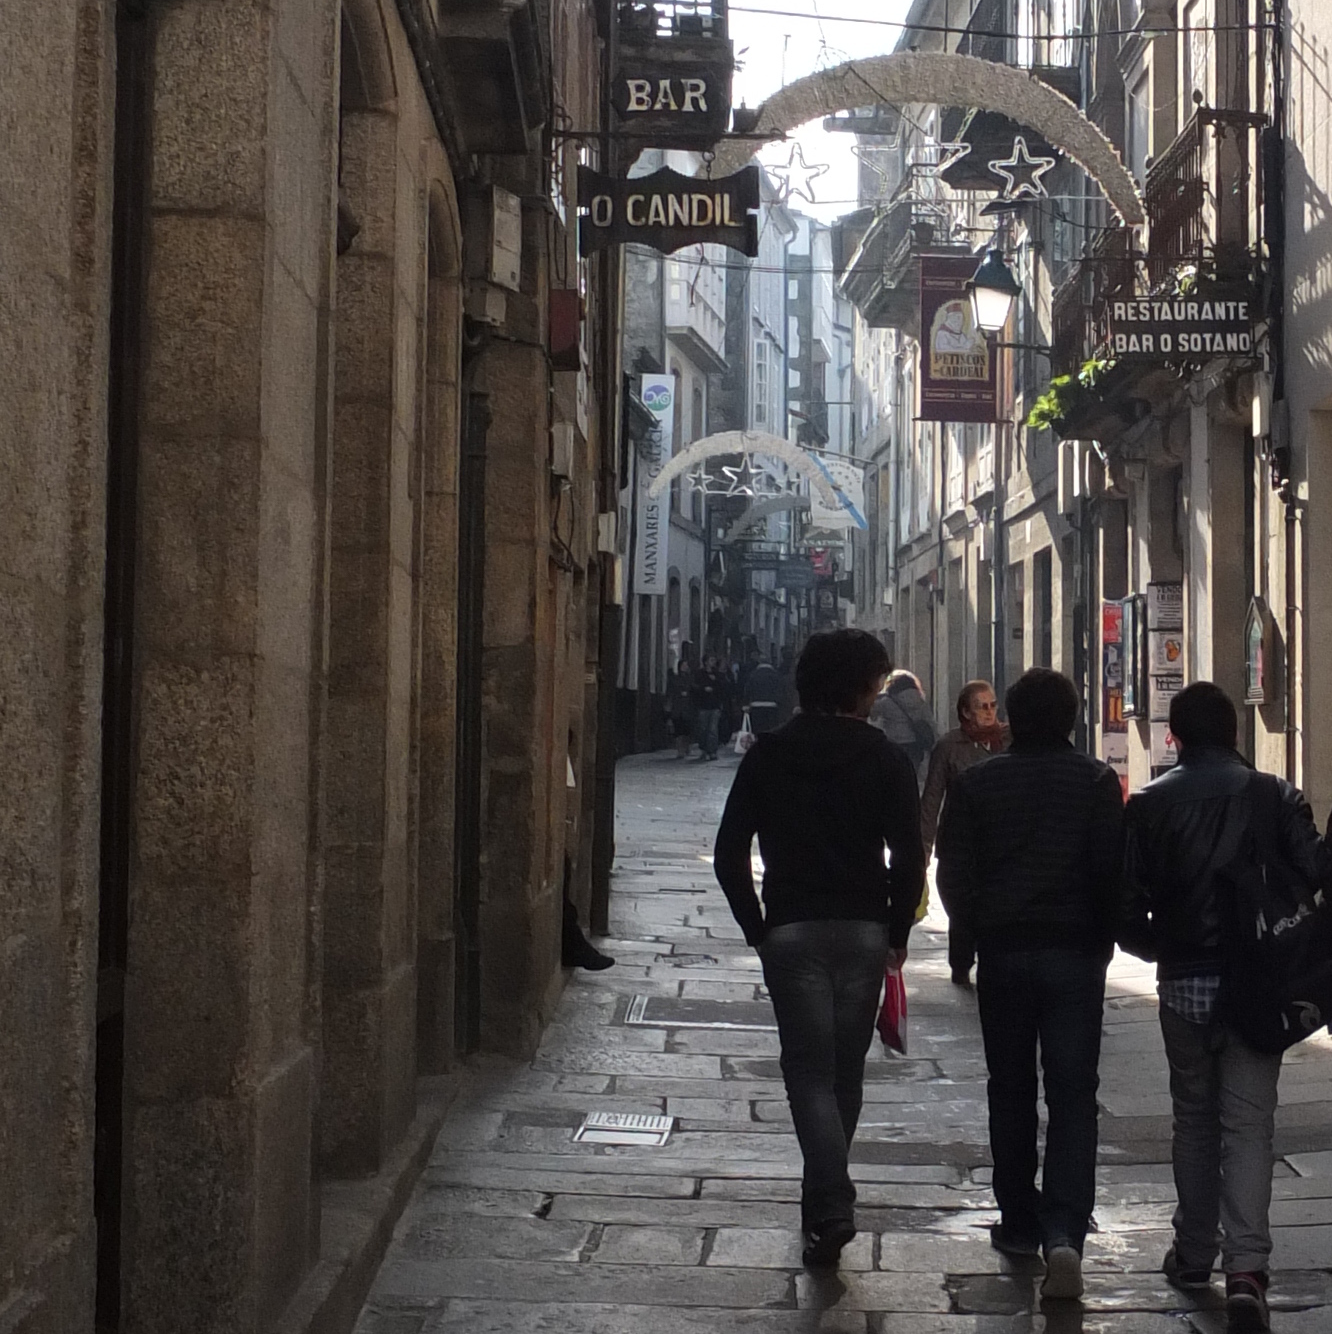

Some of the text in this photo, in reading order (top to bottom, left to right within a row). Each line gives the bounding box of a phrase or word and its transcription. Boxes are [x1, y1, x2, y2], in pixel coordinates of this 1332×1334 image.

[625, 77, 708, 113] BAR
[591, 193, 744, 227] O CANDIL
[1113, 300, 1250, 322] RESTAURANTE
[1114, 332, 1251, 354] BAR O SOTANO
[643, 504, 660, 585] MANXARES
